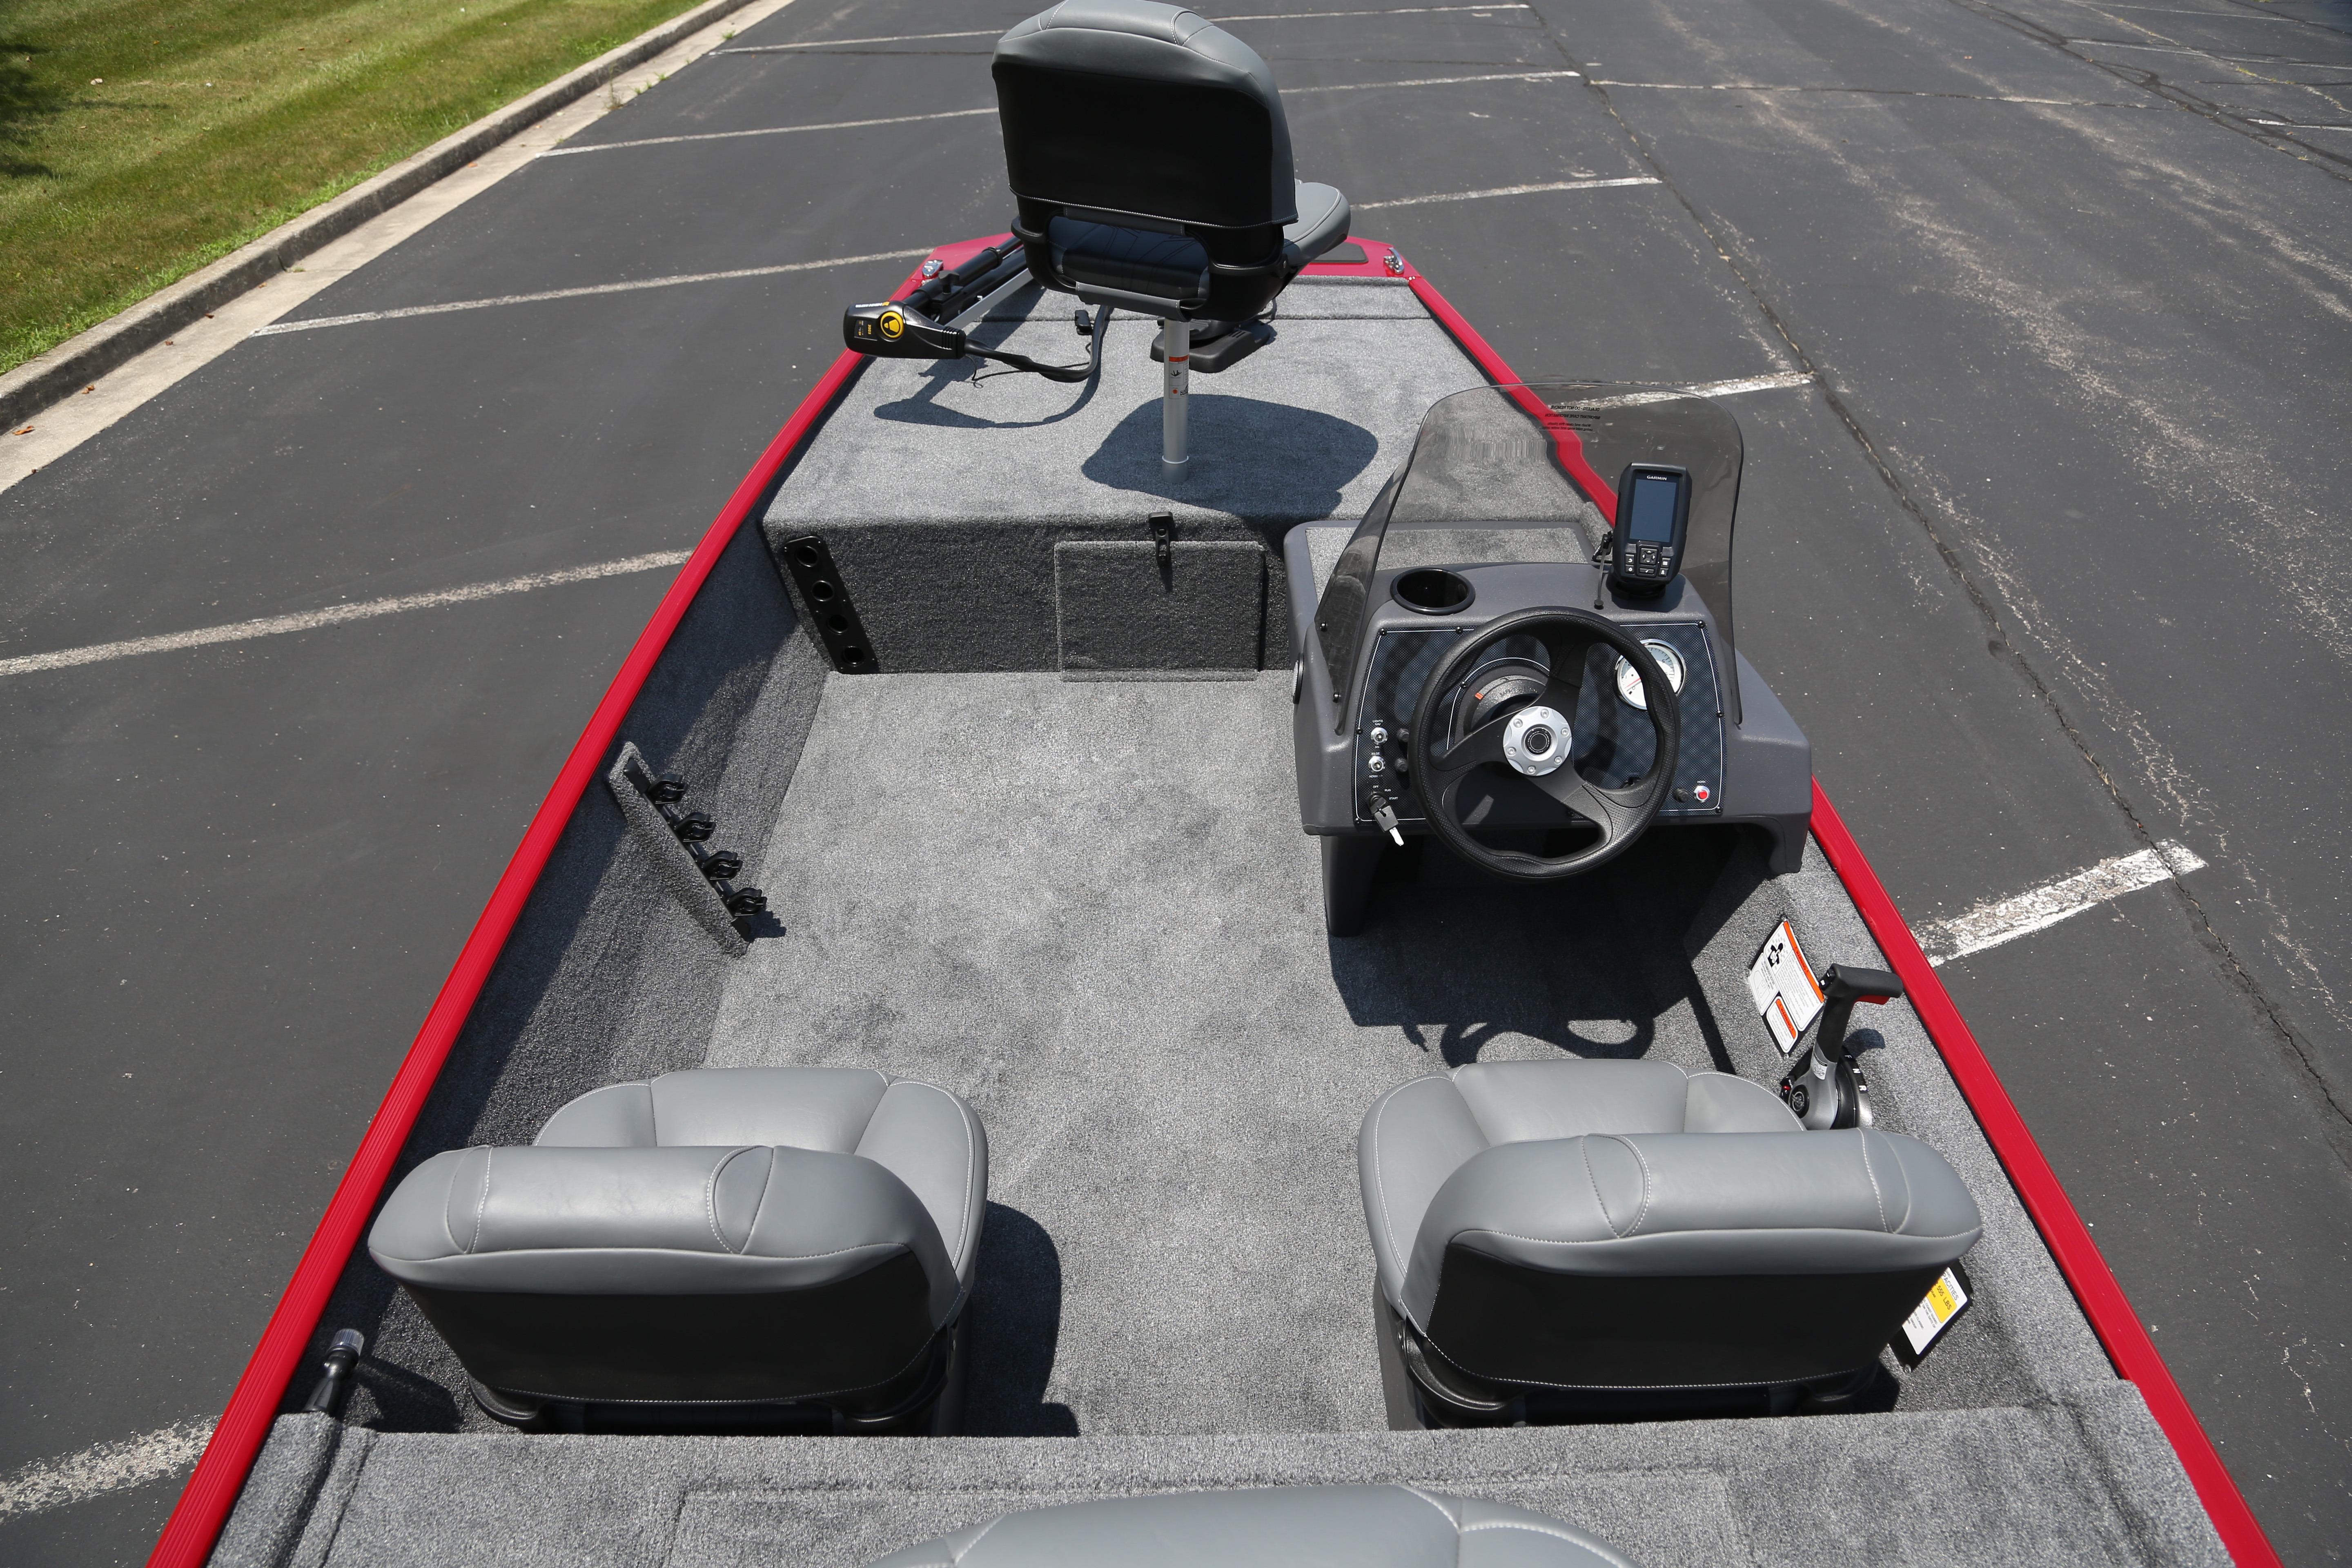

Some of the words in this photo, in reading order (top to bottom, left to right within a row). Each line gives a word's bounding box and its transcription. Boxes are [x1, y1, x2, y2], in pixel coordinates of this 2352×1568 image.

[1797, 950, 1806, 970] WARNING
[1780, 1007, 1792, 1029] WARNING
[1936, 1285, 1945, 1297] 555
[1943, 1296, 1952, 1310] LBS
